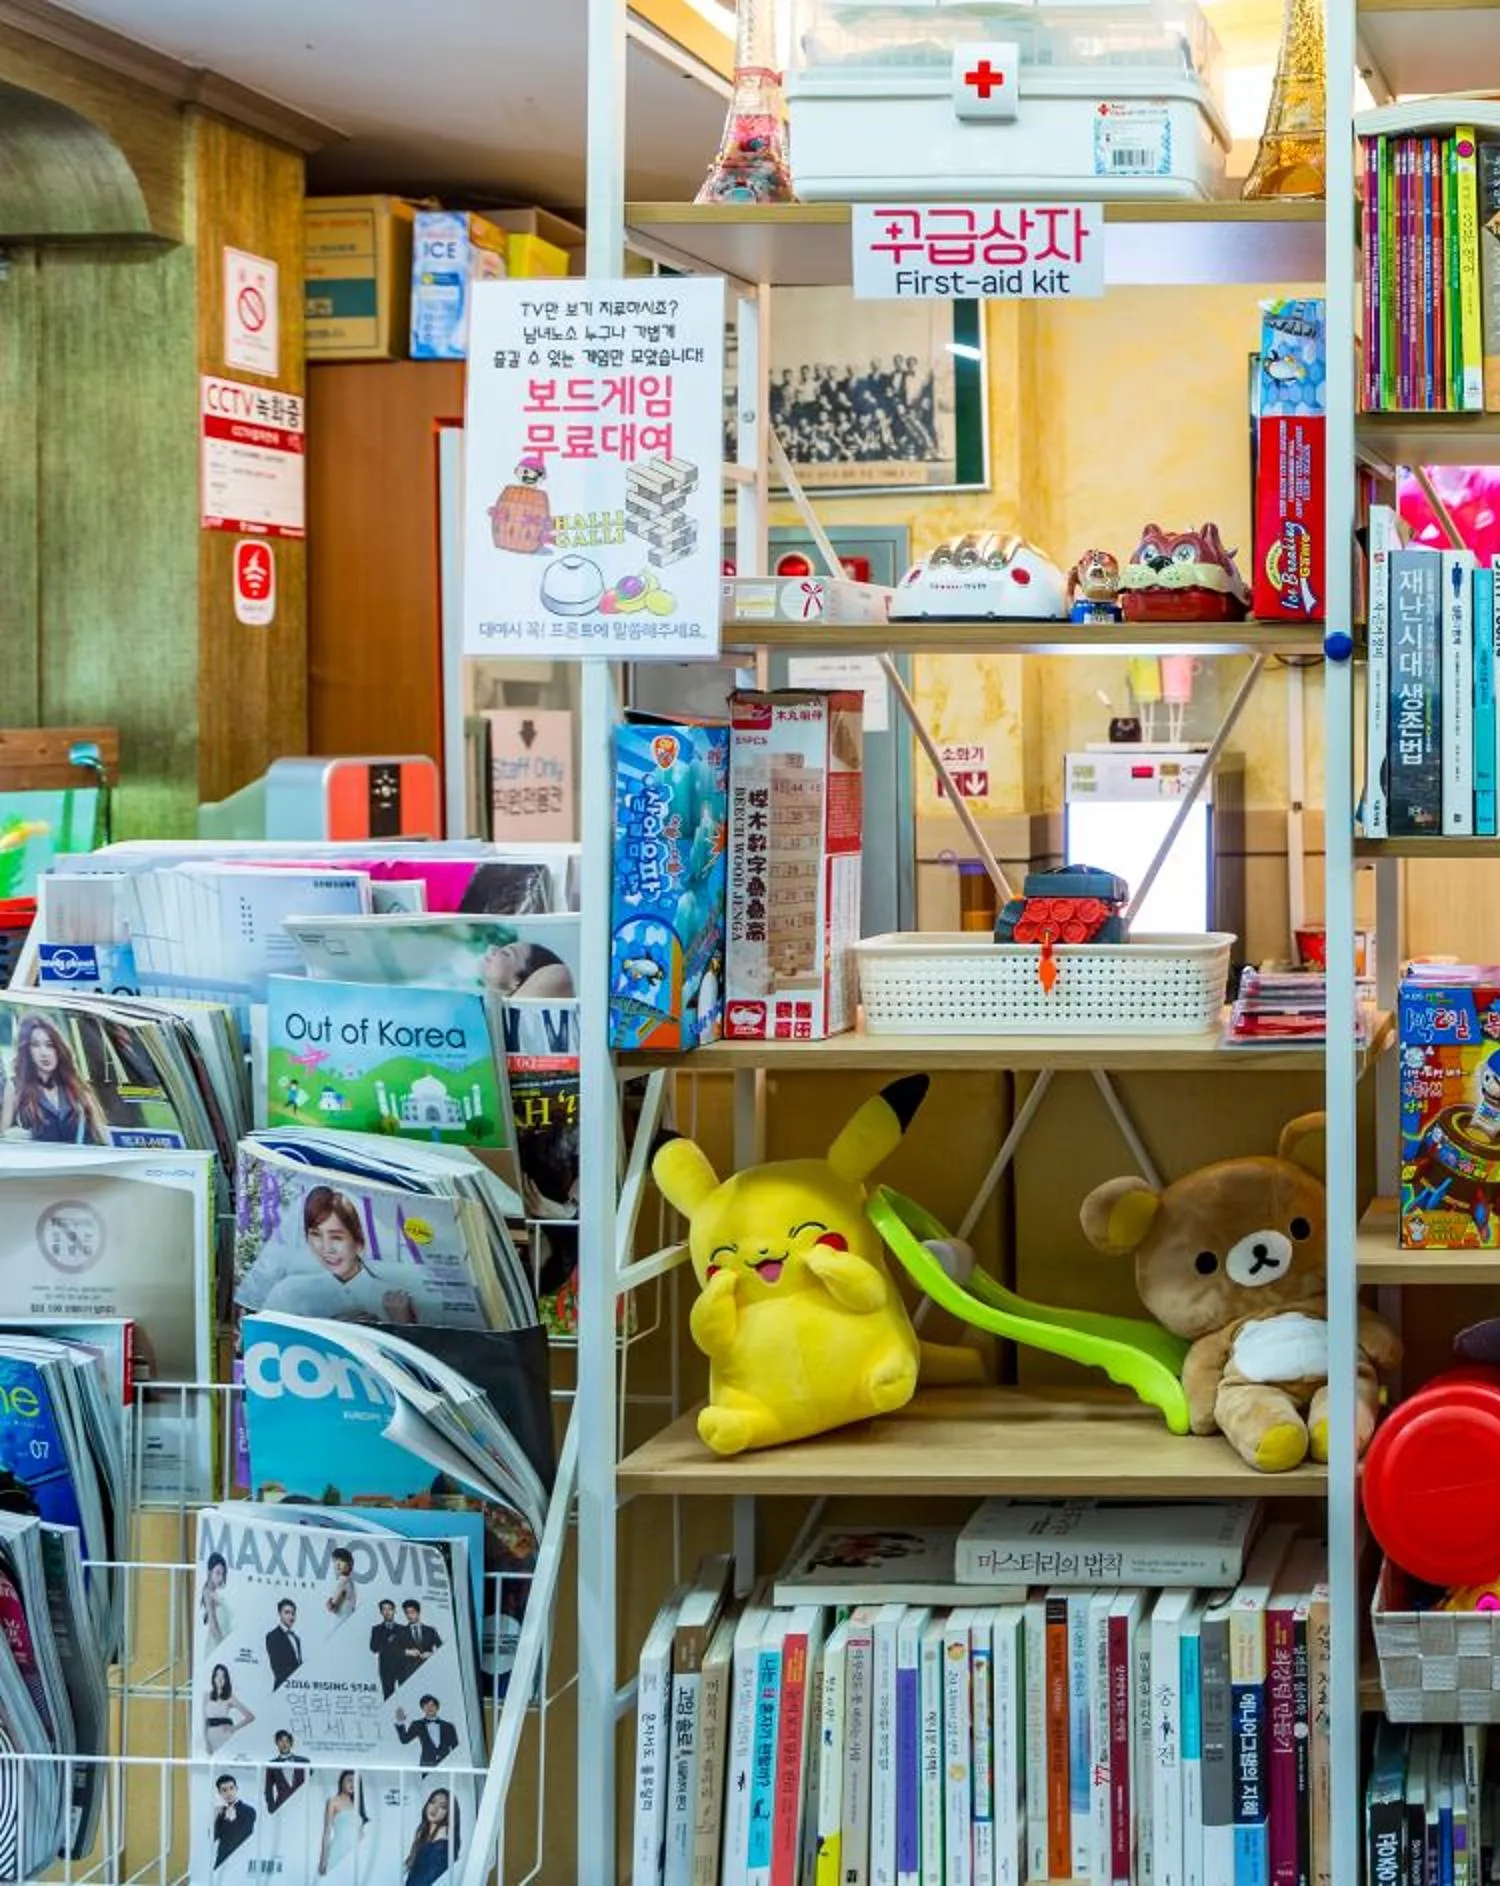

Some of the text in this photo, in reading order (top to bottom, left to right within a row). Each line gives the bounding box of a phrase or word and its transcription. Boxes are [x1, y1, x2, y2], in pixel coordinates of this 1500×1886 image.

[423, 240, 457, 260] ICE
[870, 208, 1090, 265] 구급상자
[896, 270, 1070, 295] First-aid kit
[521, 300, 678, 320] TV만 보기 지루하시죠?
[524, 324, 675, 344] 남녀노소 누구나 가볍게
[528, 350, 541, 366] 수
[523, 375, 672, 417] 보드게임
[522, 423, 672, 462] 무료대여
[1399, 569, 1425, 765] 재난시대 생존법
[942, 746, 985, 762] 소화기
[731, 787, 746, 942] BEECH WOOD JENGA
[285, 1013, 467, 1049] Out of Korea
[200, 1518, 449, 1588] MAX MOVIE
[977, 1550, 1123, 1578] 마스터리의 법칙
[284, 1680, 377, 1692] 2016 RISING STAR
[1273, 1648, 1292, 1753] 최강팀 만들기
[1238, 1693, 1259, 1817] 에니어그램의 지혜
